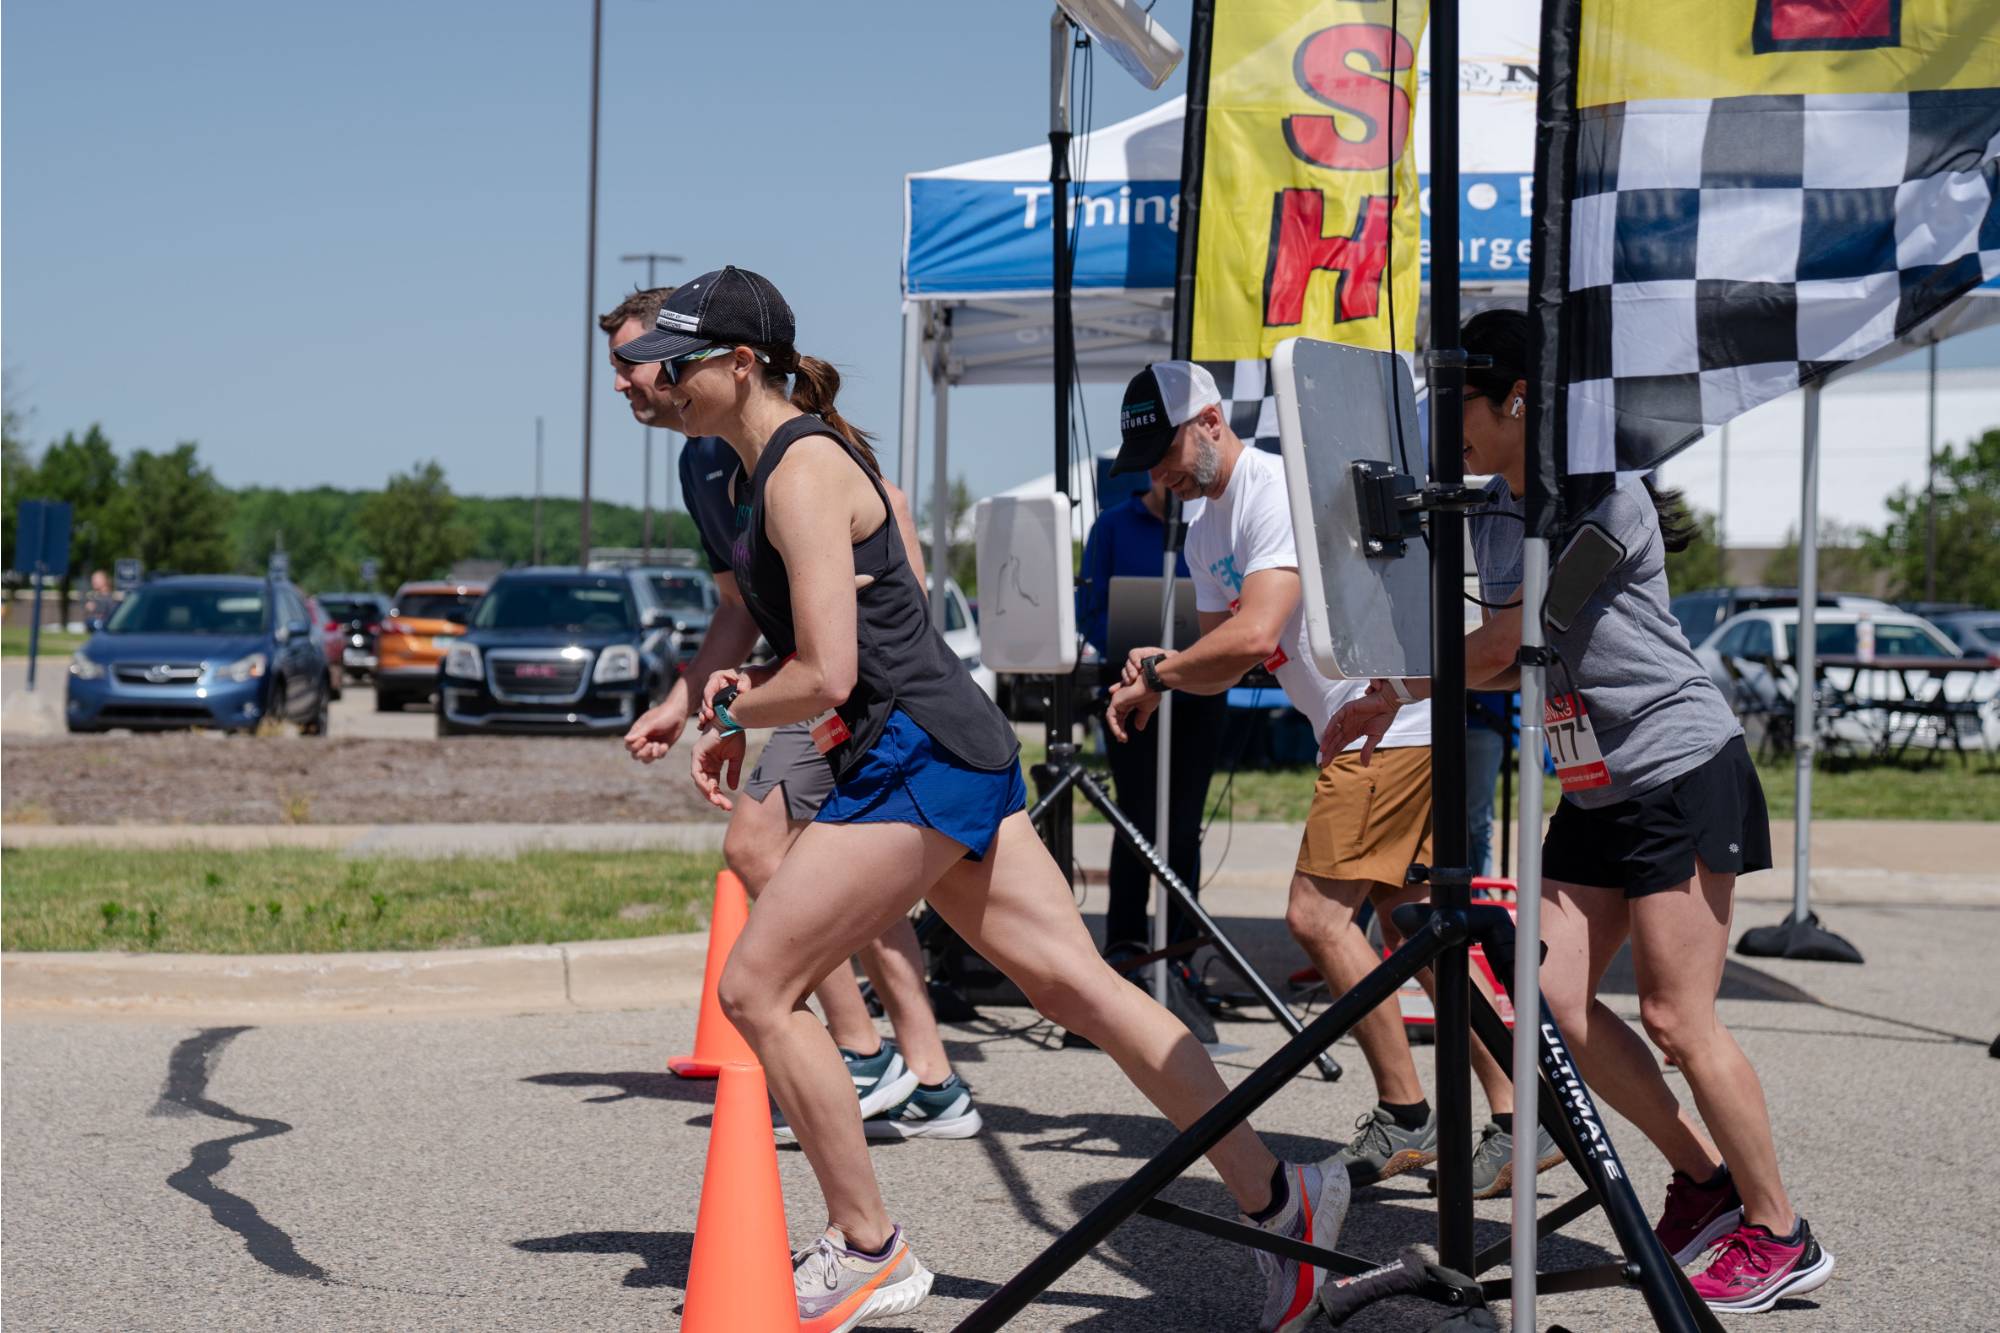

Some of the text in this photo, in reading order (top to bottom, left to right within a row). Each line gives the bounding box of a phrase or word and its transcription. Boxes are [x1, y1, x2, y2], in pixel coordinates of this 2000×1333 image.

[1013, 185, 1181, 233] Tmin
[1262, 0, 1413, 327] SH
[1541, 1023, 1622, 1180] ULTIMATE
[1545, 1055, 1597, 1159] SUPPORT
